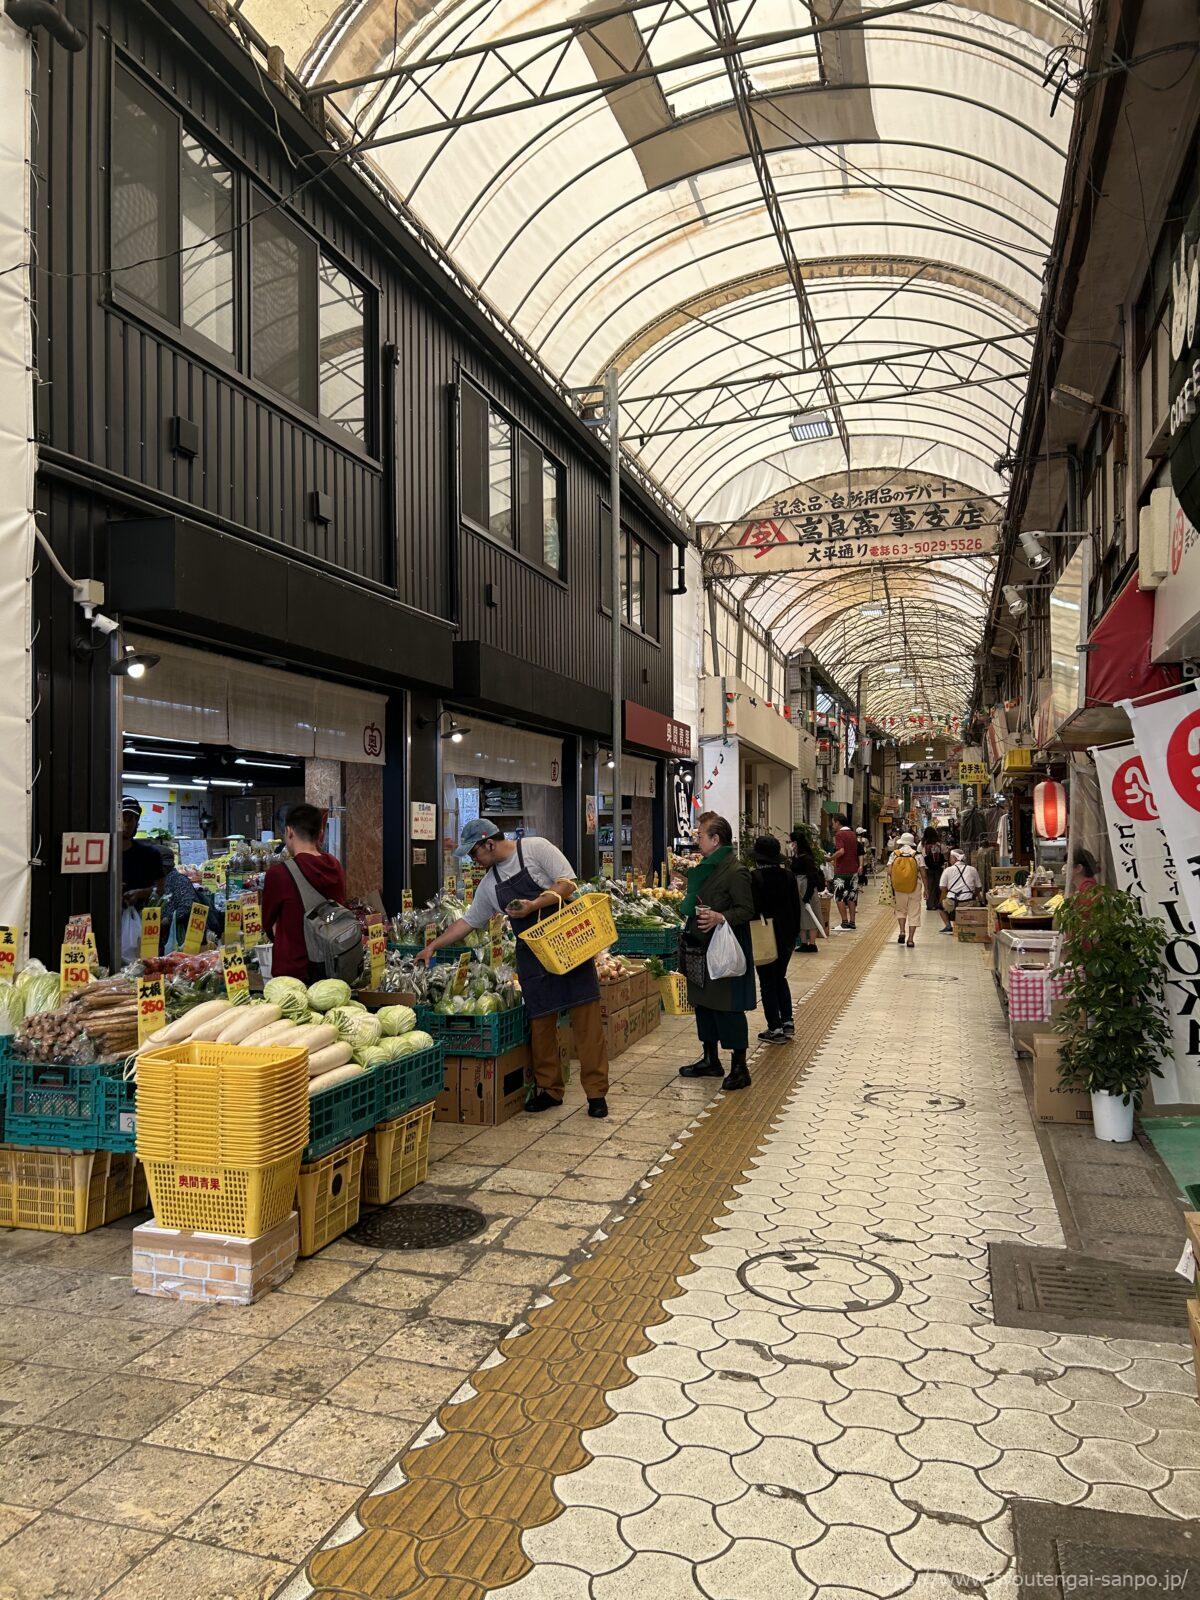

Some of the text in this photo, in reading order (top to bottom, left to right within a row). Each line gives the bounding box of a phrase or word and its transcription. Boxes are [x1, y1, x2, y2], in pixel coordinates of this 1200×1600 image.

[64, 837, 104, 866] 出口
[227, 912, 241, 923] 150
[144, 925, 159, 936] 180
[245, 922, 261, 934] 550
[64, 951, 86, 964] ごぼう
[64, 968, 89, 983] 150
[227, 970, 246, 984] 200
[140, 981, 162, 999] 大根
[141, 1000, 164, 1015] 350
[178, 1175, 221, 1191] 奥間青果
